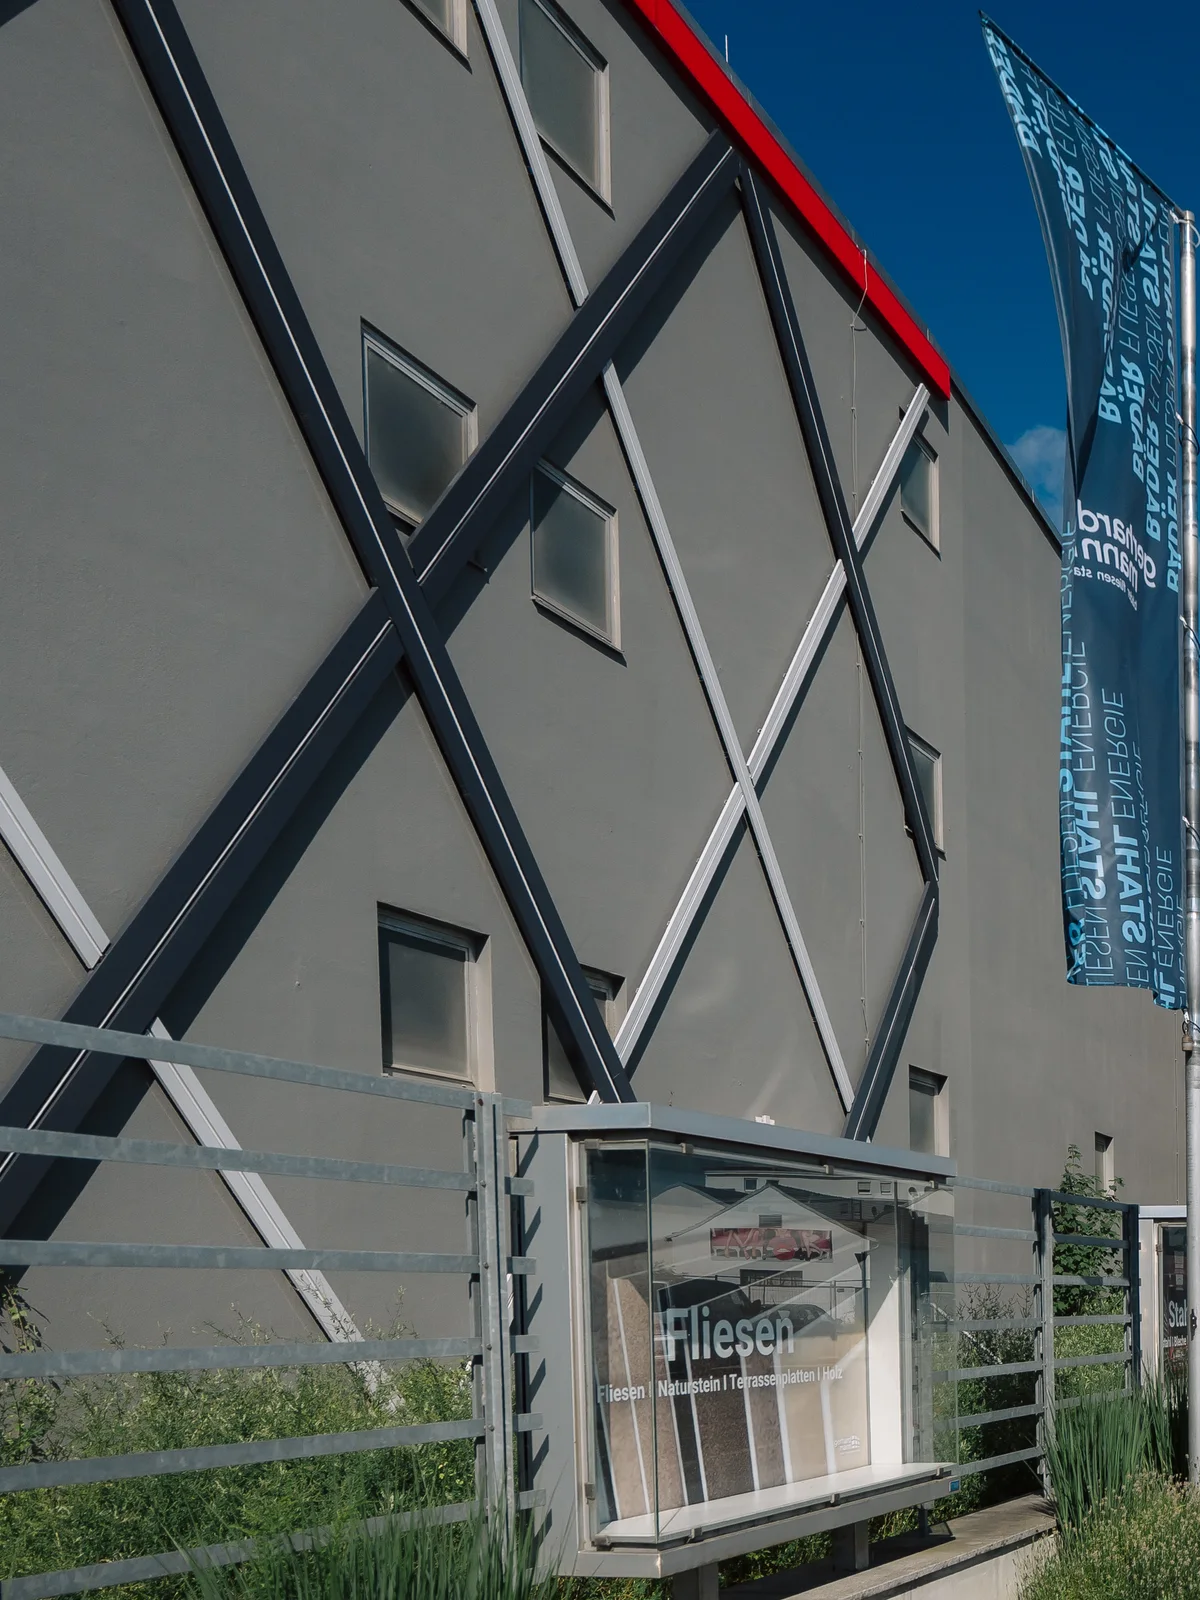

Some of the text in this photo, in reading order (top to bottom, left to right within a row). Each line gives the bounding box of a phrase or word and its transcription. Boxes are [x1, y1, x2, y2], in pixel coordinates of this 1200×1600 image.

[667, 1305, 795, 1361] Fliesen
[658, 1375, 721, 1398] Naturstein
[729, 1369, 815, 1391] Terrassenplatten
[822, 1366, 843, 1380] Holz
